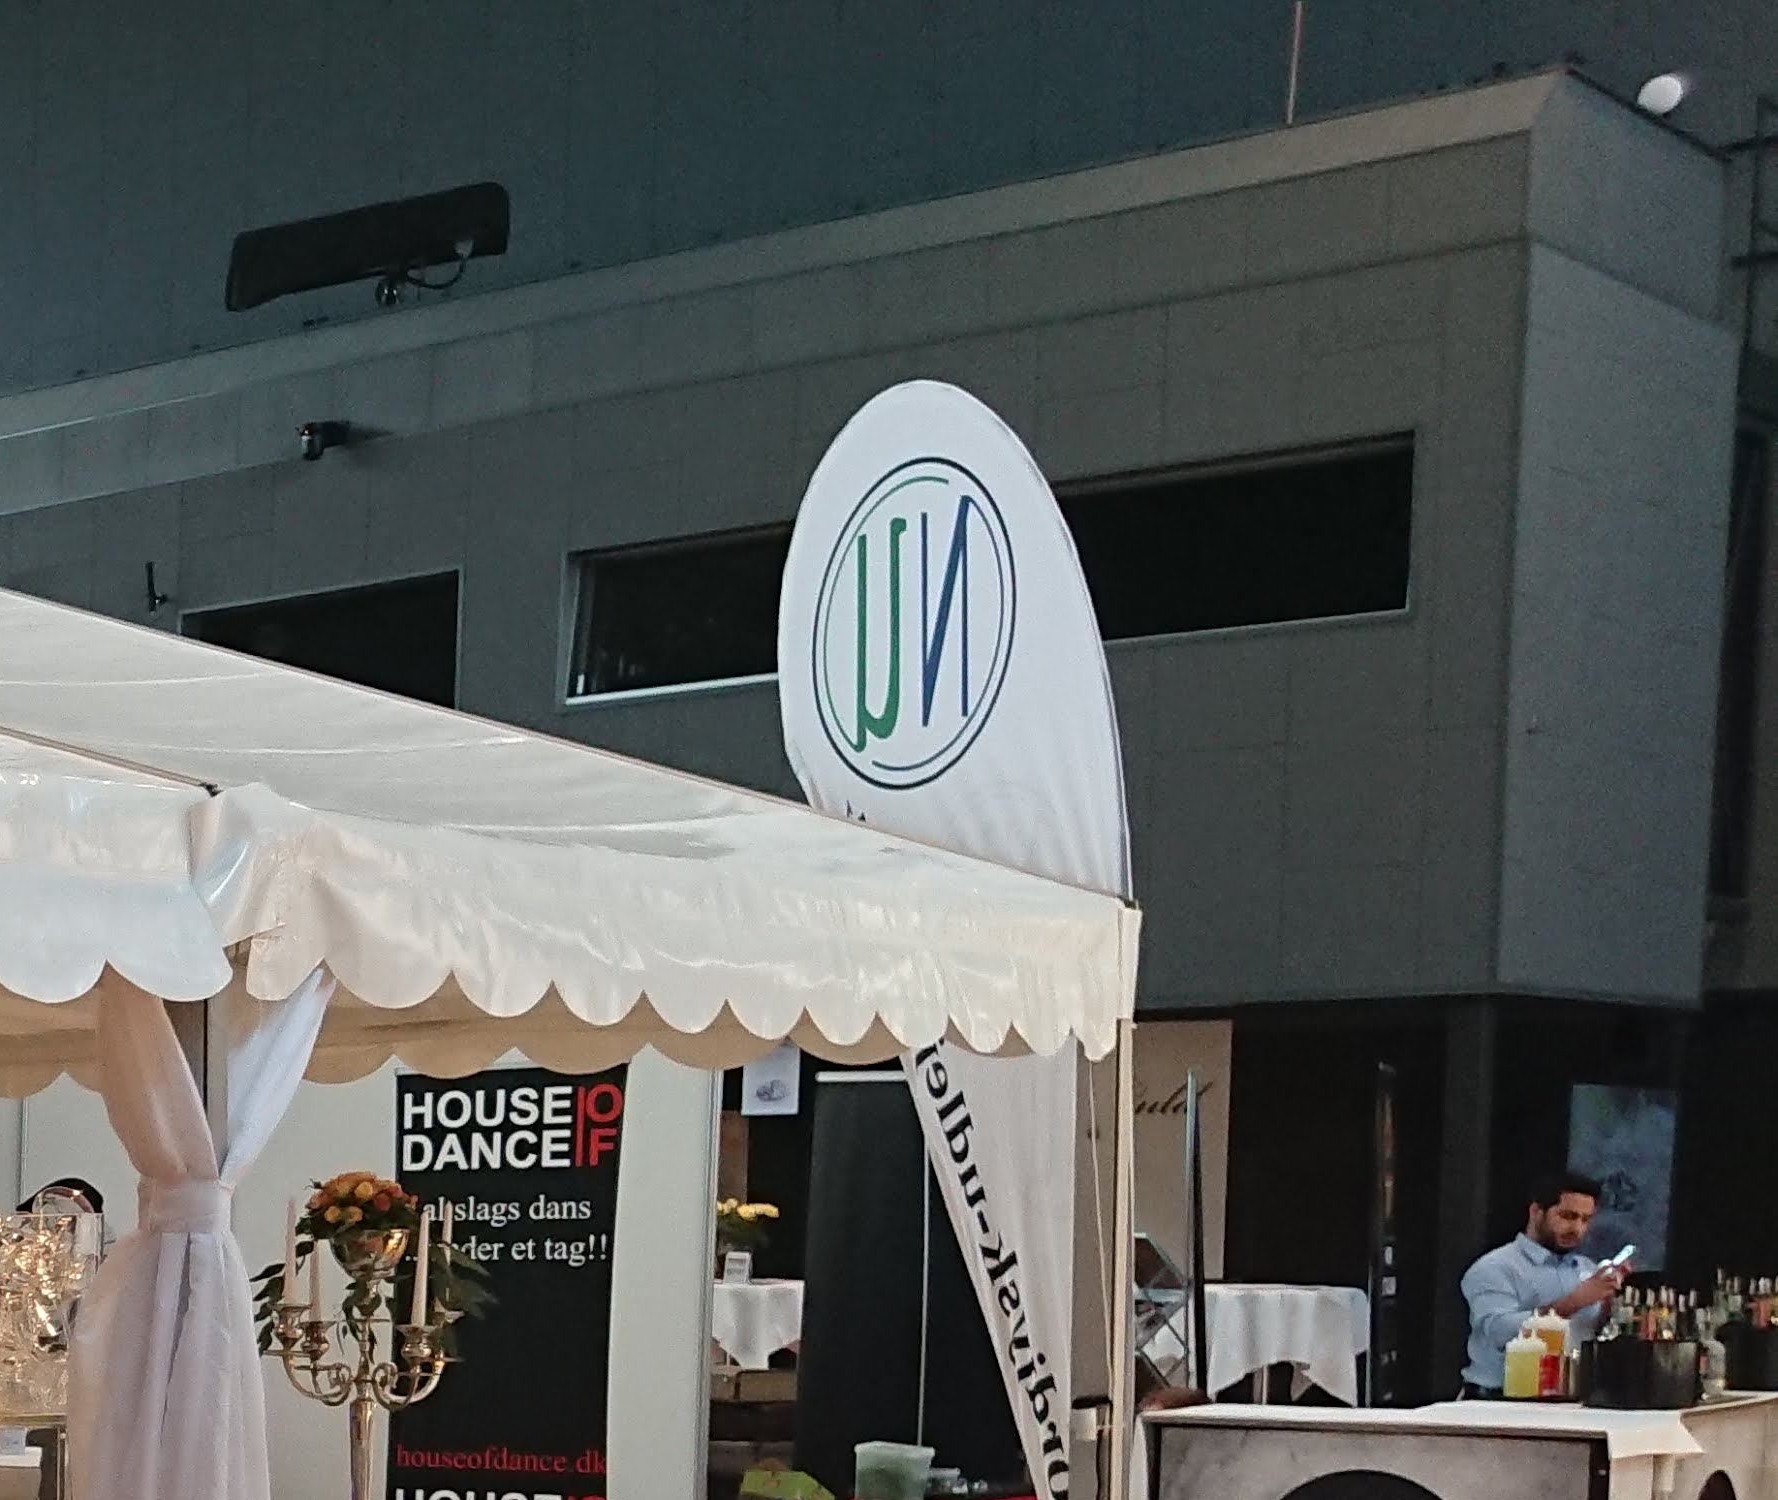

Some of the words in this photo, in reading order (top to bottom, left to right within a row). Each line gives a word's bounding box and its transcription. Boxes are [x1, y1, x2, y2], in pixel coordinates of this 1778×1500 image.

[403, 1085, 574, 1130] HOUSE
[402, 1128, 572, 1172] DANCE
[453, 1195, 521, 1228] slags
[528, 1194, 592, 1221] dans
[511, 1238, 537, 1261] et
[544, 1233, 608, 1268] tag!!
